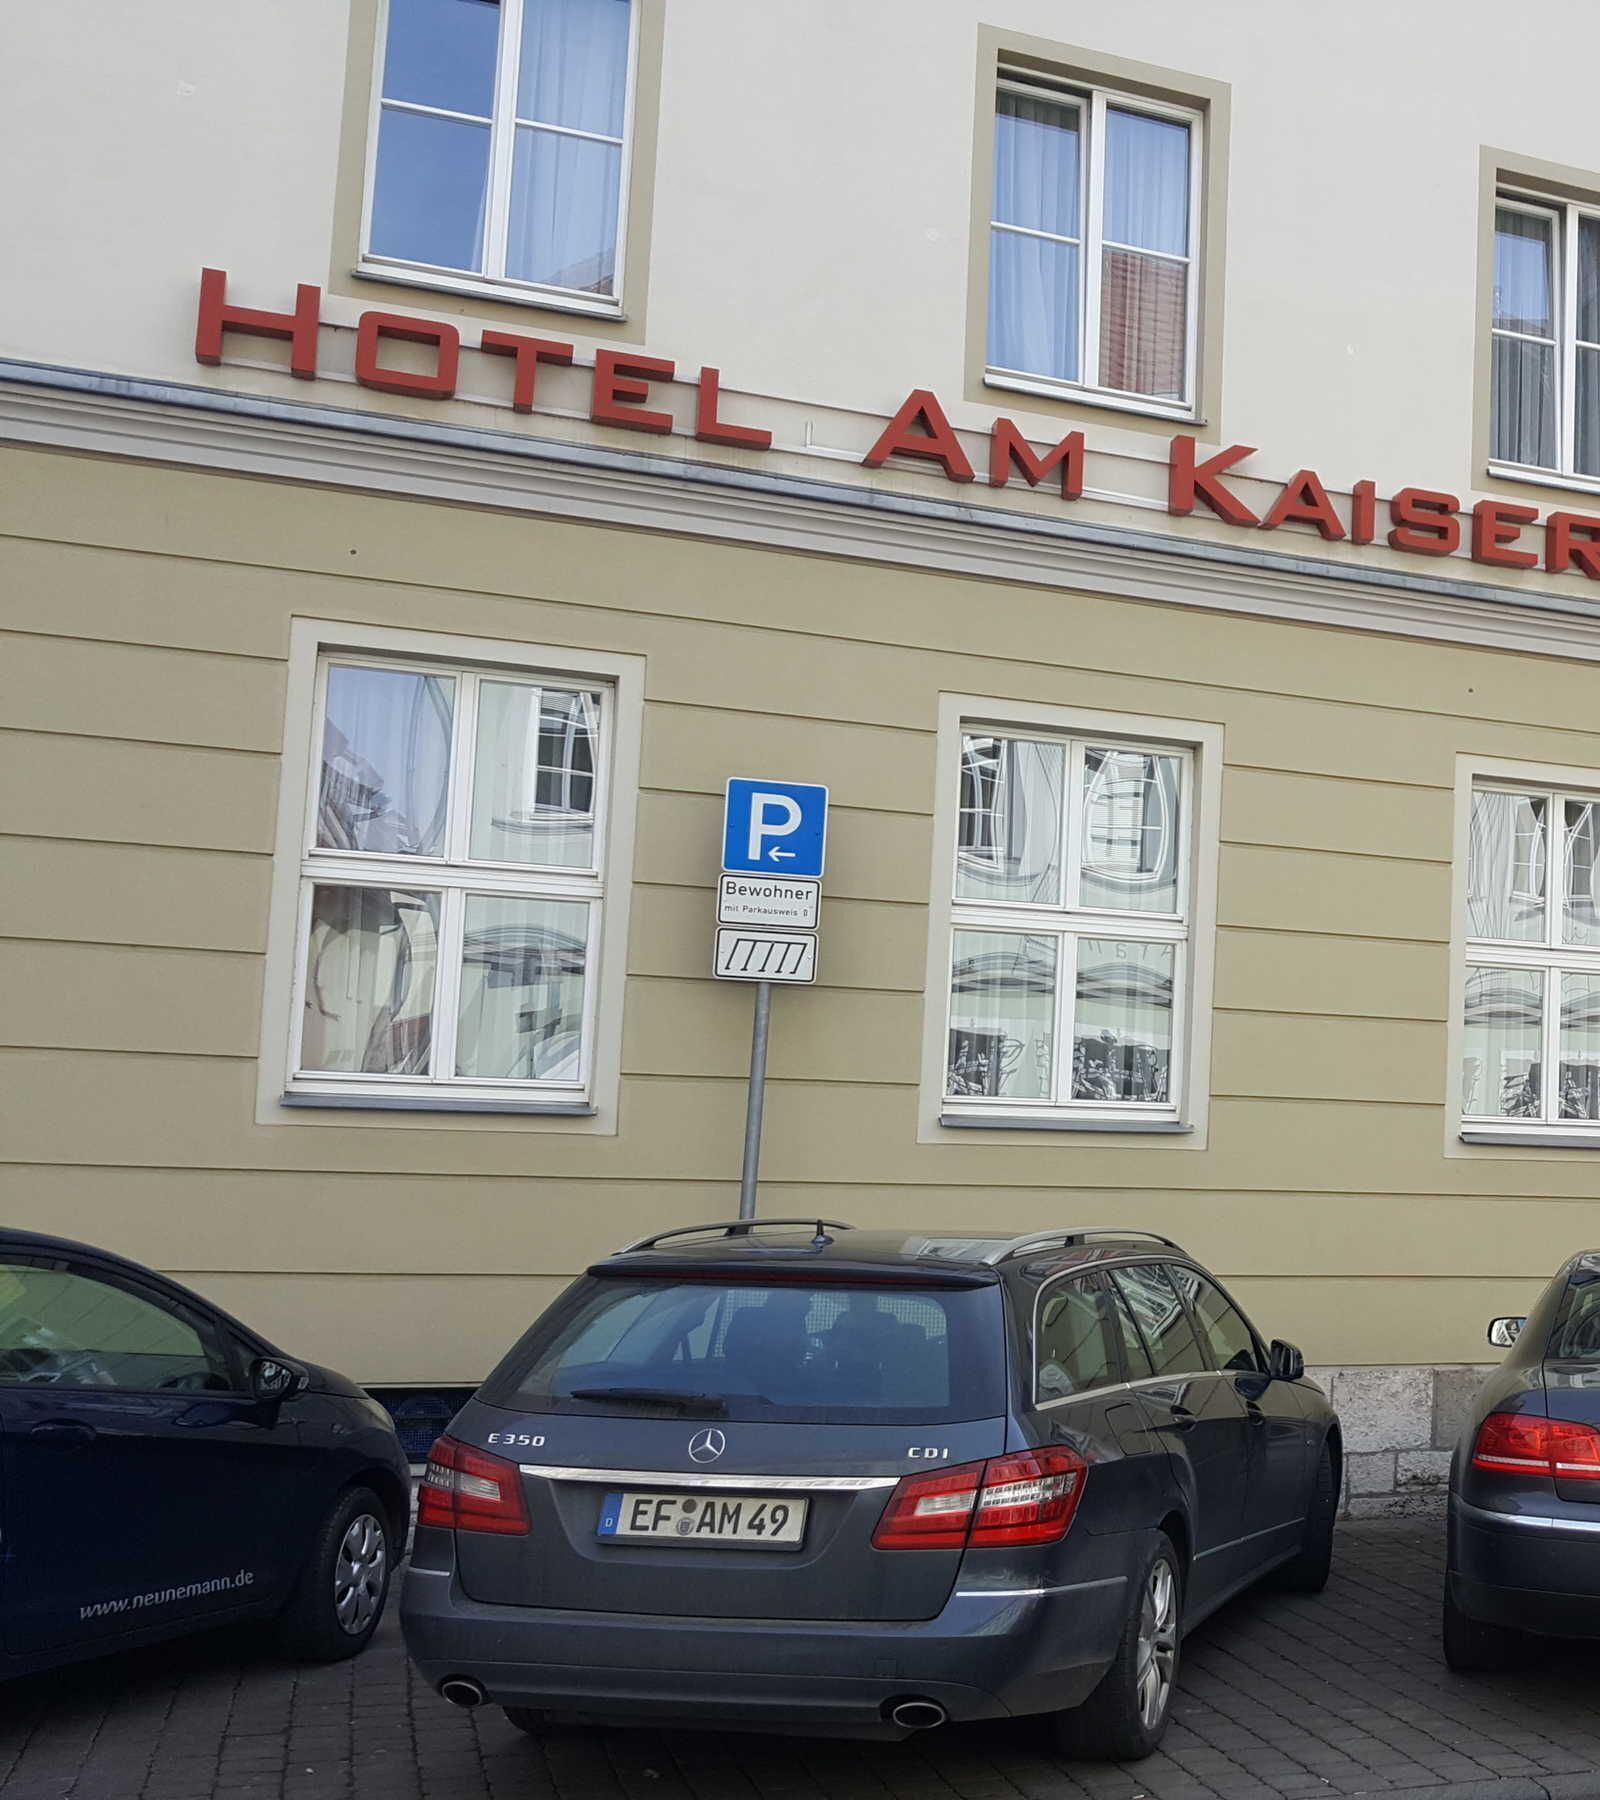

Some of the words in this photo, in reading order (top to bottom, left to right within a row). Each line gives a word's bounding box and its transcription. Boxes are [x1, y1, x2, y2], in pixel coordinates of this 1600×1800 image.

[195, 267, 773, 450] HOTEL
[860, 388, 1085, 501] AM
[747, 791, 802, 861] P
[725, 881, 813, 900] Bewohner
[742, 905, 798, 916] Parkausweis
[487, 1432, 501, 1445] E
[502, 1433, 546, 1447] 350
[908, 1447, 949, 1459] CDI
[747, 1502, 790, 1537] 49
[79, 1568, 255, 1620] www.neunemann.de
